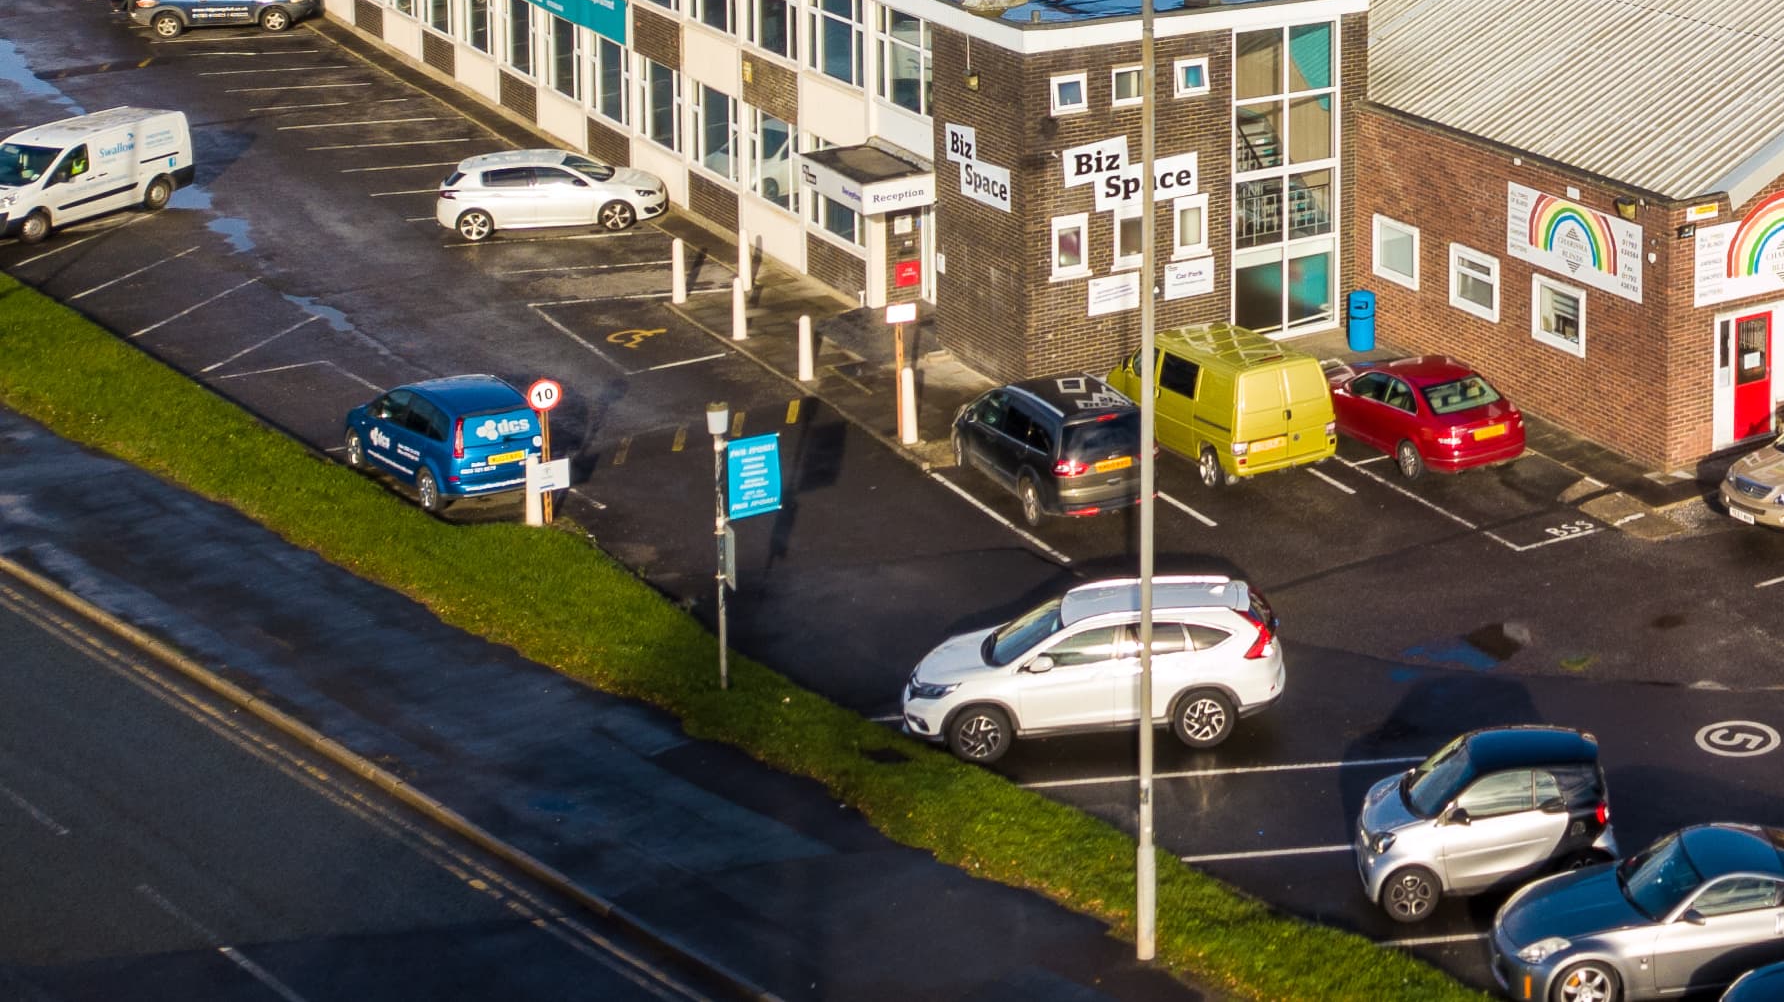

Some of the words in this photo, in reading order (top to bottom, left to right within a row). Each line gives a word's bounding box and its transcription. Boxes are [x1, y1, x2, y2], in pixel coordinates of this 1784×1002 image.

[99, 141, 135, 157] Swallow
[950, 130, 972, 159] Biz
[1074, 151, 1120, 176] Biz
[965, 164, 1008, 201] Space
[1105, 169, 1192, 200] Spce
[873, 189, 924, 203] Reception
[1558, 238, 1588, 253] CHARISMA
[1562, 251, 1583, 263] BLINDS
[535, 388, 553, 402] 10
[497, 418, 530, 436] dcs
[1709, 728, 1764, 750] 5
